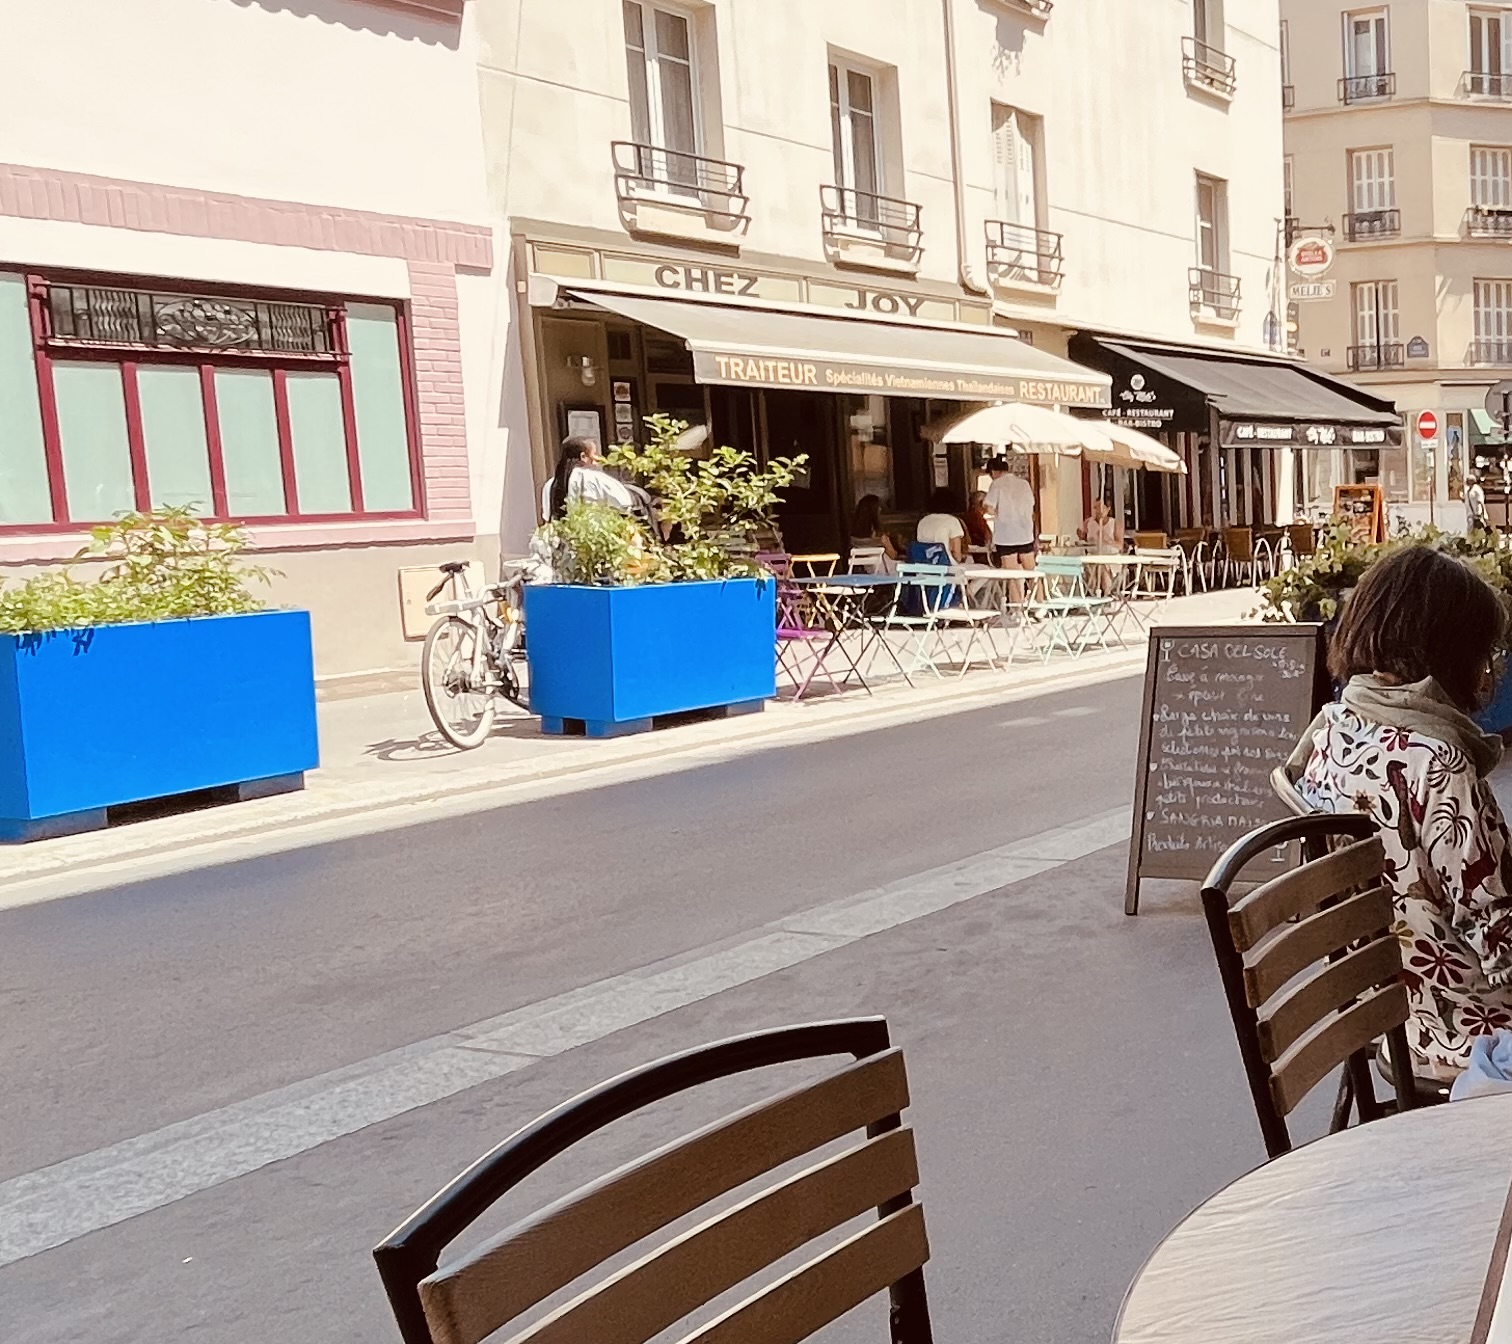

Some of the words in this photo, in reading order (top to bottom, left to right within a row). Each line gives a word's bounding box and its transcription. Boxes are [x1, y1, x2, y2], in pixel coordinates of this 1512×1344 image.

[654, 264, 760, 298] CHEZ
[844, 289, 926, 317] JOY
[715, 356, 818, 385] TRAITEUR
[826, 368, 884, 387] Spécialités
[1019, 381, 1101, 403] RESTAURANT
[1177, 643, 1219, 660] CASA
[1224, 643, 1252, 658] DEL
[1254, 644, 1288, 660] SOLE
